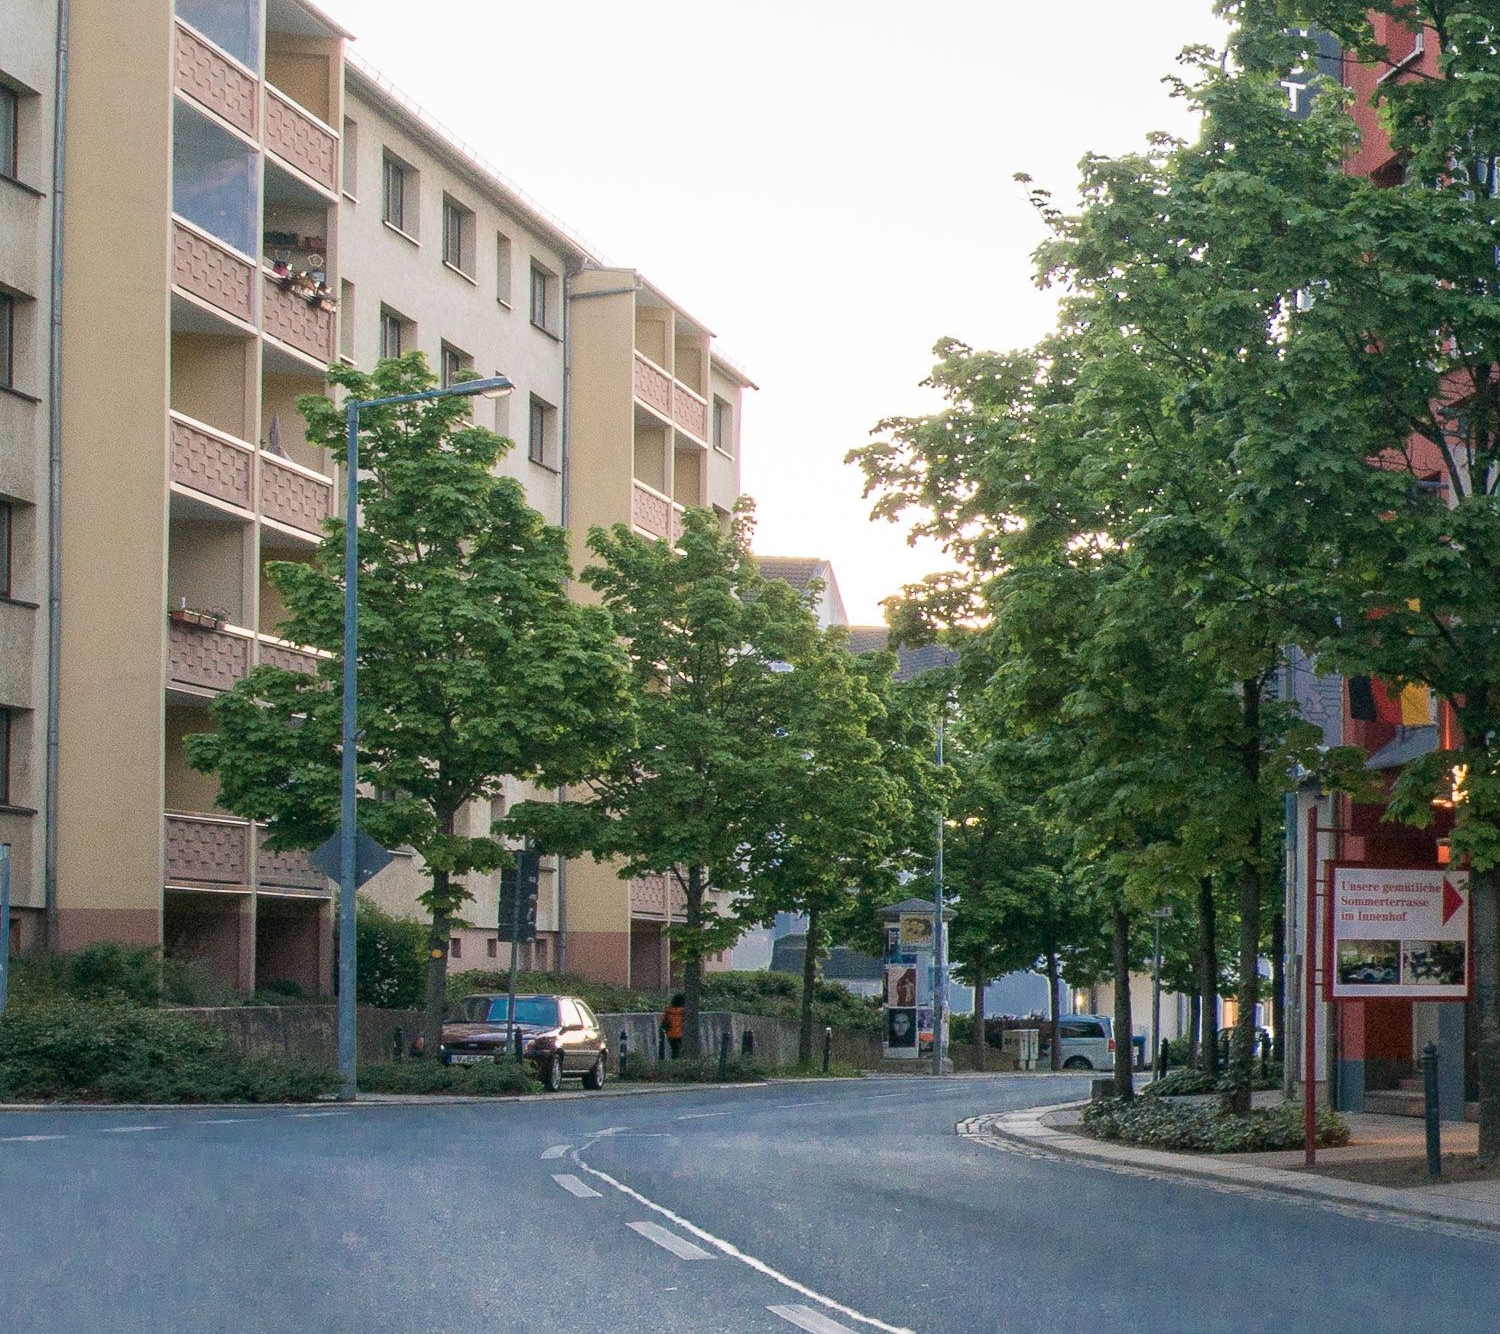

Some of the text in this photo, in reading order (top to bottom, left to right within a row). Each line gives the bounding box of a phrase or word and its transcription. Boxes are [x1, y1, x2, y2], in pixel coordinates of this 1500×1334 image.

[1342, 880, 1441, 894] Unsere gemütliche
[1341, 896, 1429, 907] Sommerterrasse
[1341, 911, 1407, 922] im Innenhof
